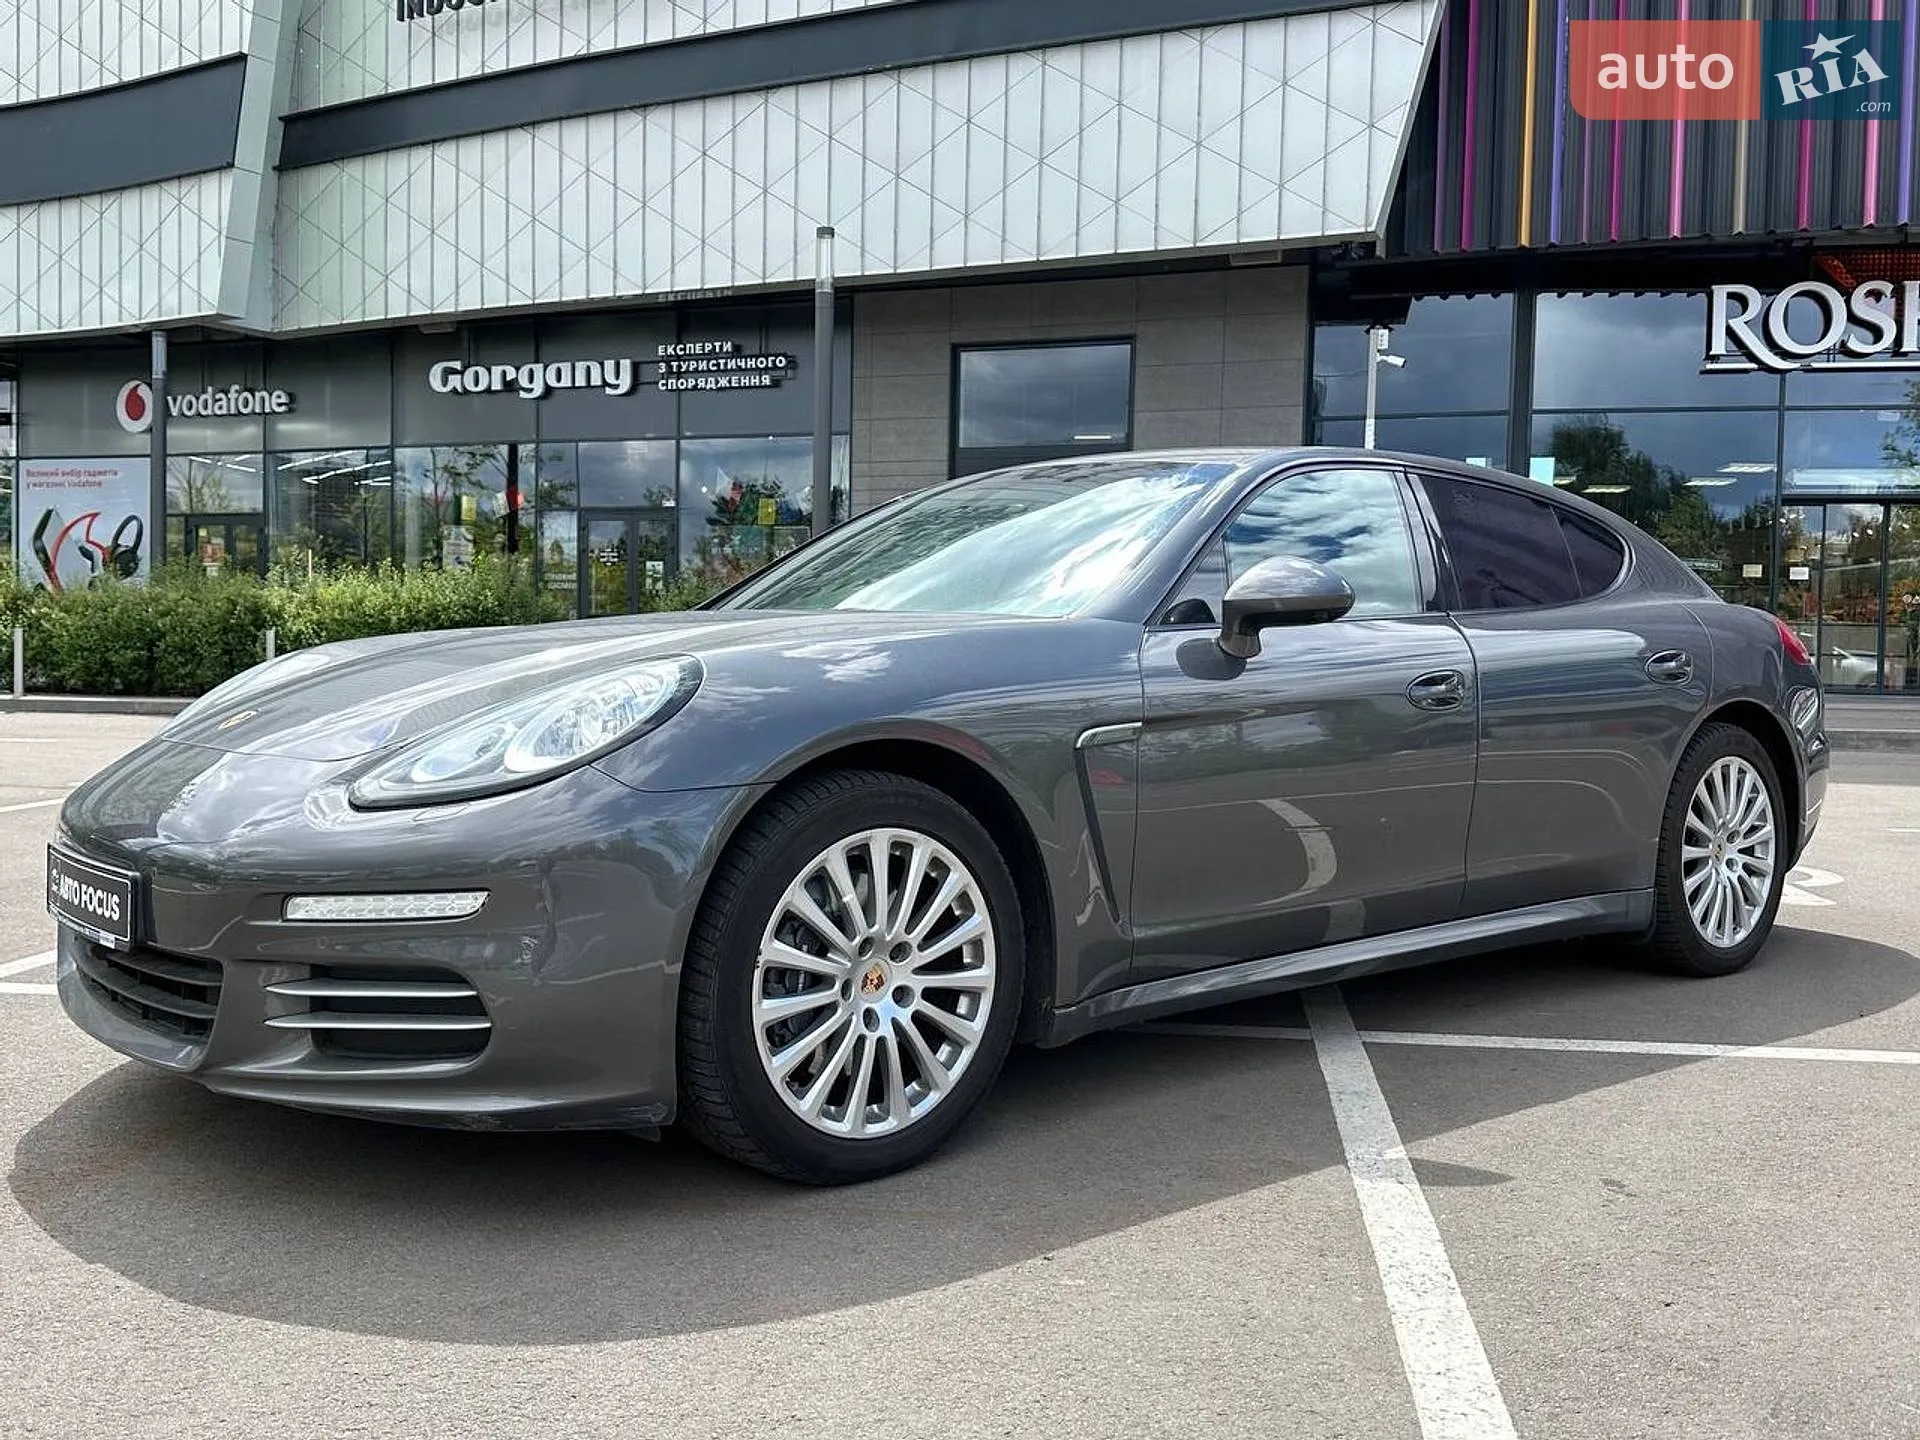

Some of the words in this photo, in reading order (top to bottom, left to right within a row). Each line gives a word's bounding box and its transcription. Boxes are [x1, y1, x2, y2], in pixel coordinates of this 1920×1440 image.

[658, 341, 732, 355] ЕКСПЕРТИ
[671, 356, 786, 372] ТУРИСТИЧНОГО
[429, 358, 632, 399] Gorgany
[658, 374, 771, 390] СПОРЯДЖЕННЯ
[167, 384, 289, 416] vodafone
[59, 874, 80, 906] AUTO
[81, 884, 120, 920] FOCUS
